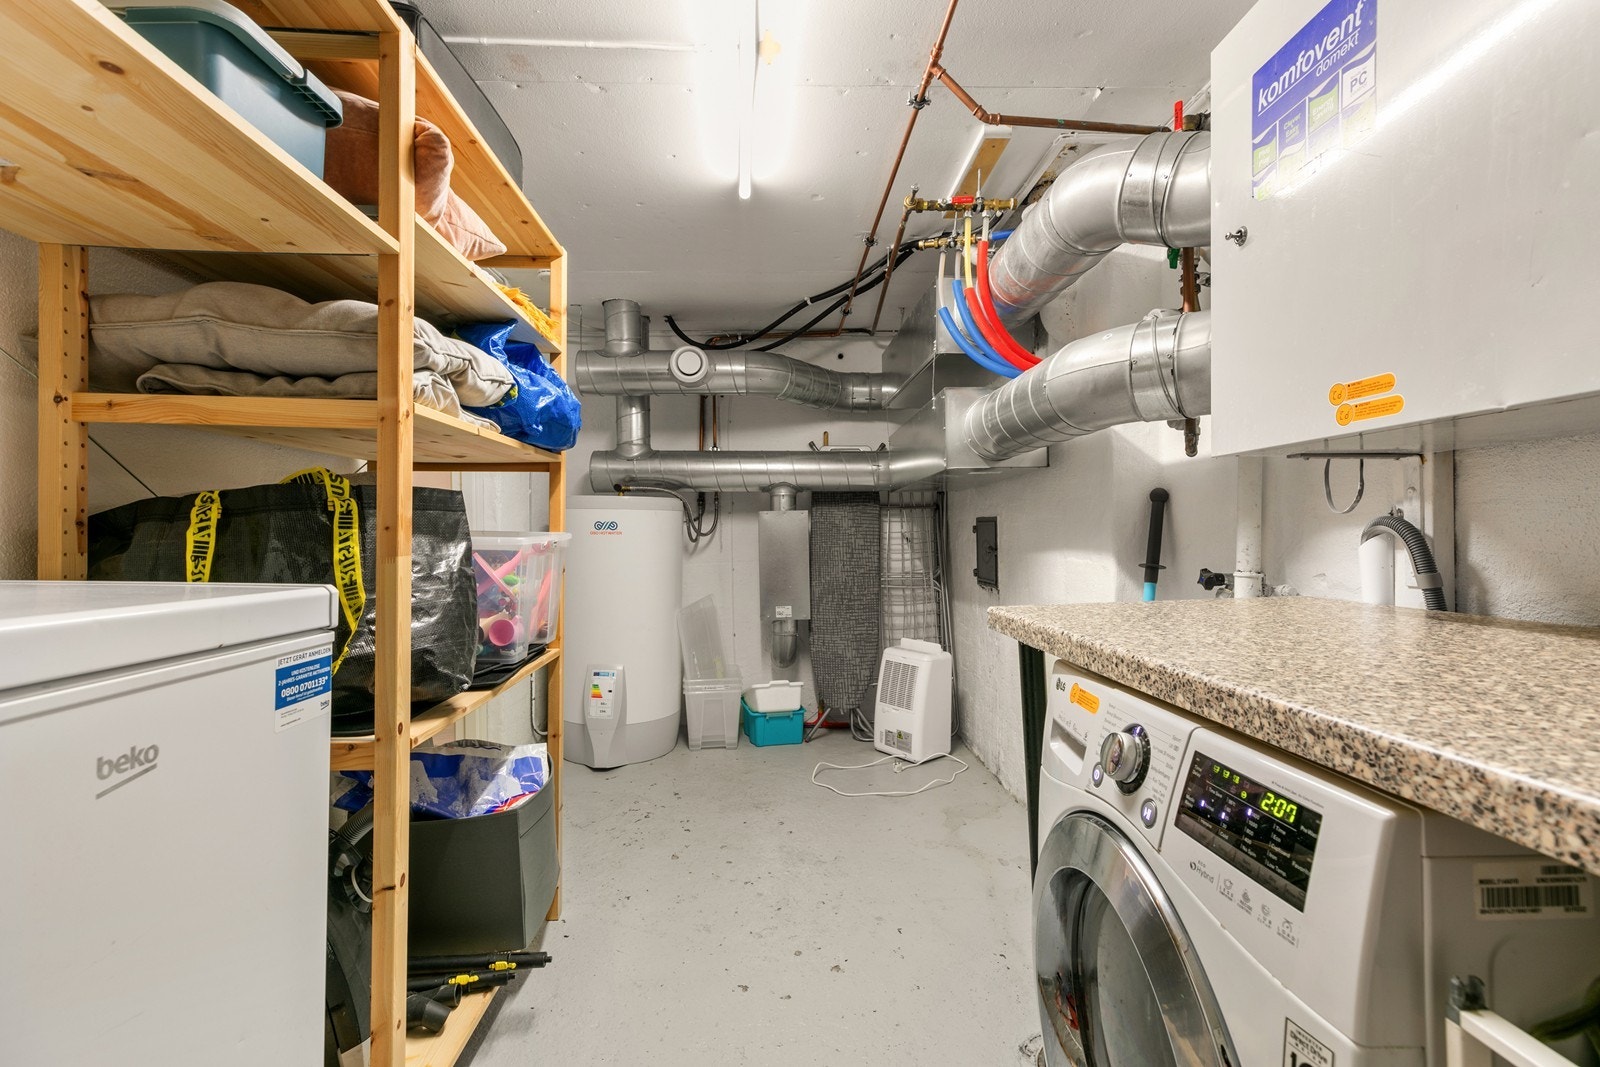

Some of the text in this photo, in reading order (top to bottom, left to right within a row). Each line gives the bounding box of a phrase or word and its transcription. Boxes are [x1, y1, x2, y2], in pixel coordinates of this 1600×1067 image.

[1258, 1, 1364, 112] komfovent
[1316, 32, 1359, 76] domekt
[1350, 71, 1367, 93] PC
[278, 657, 292, 666] JETZT
[309, 648, 331, 656] ANMELDEN
[281, 685, 299, 697] 0800
[96, 744, 159, 780] beko
[1260, 792, 1297, 823] 2:07
[1196, 867, 1214, 884] Hybrid
[1290, 1030, 1328, 1064] Direct Drive
